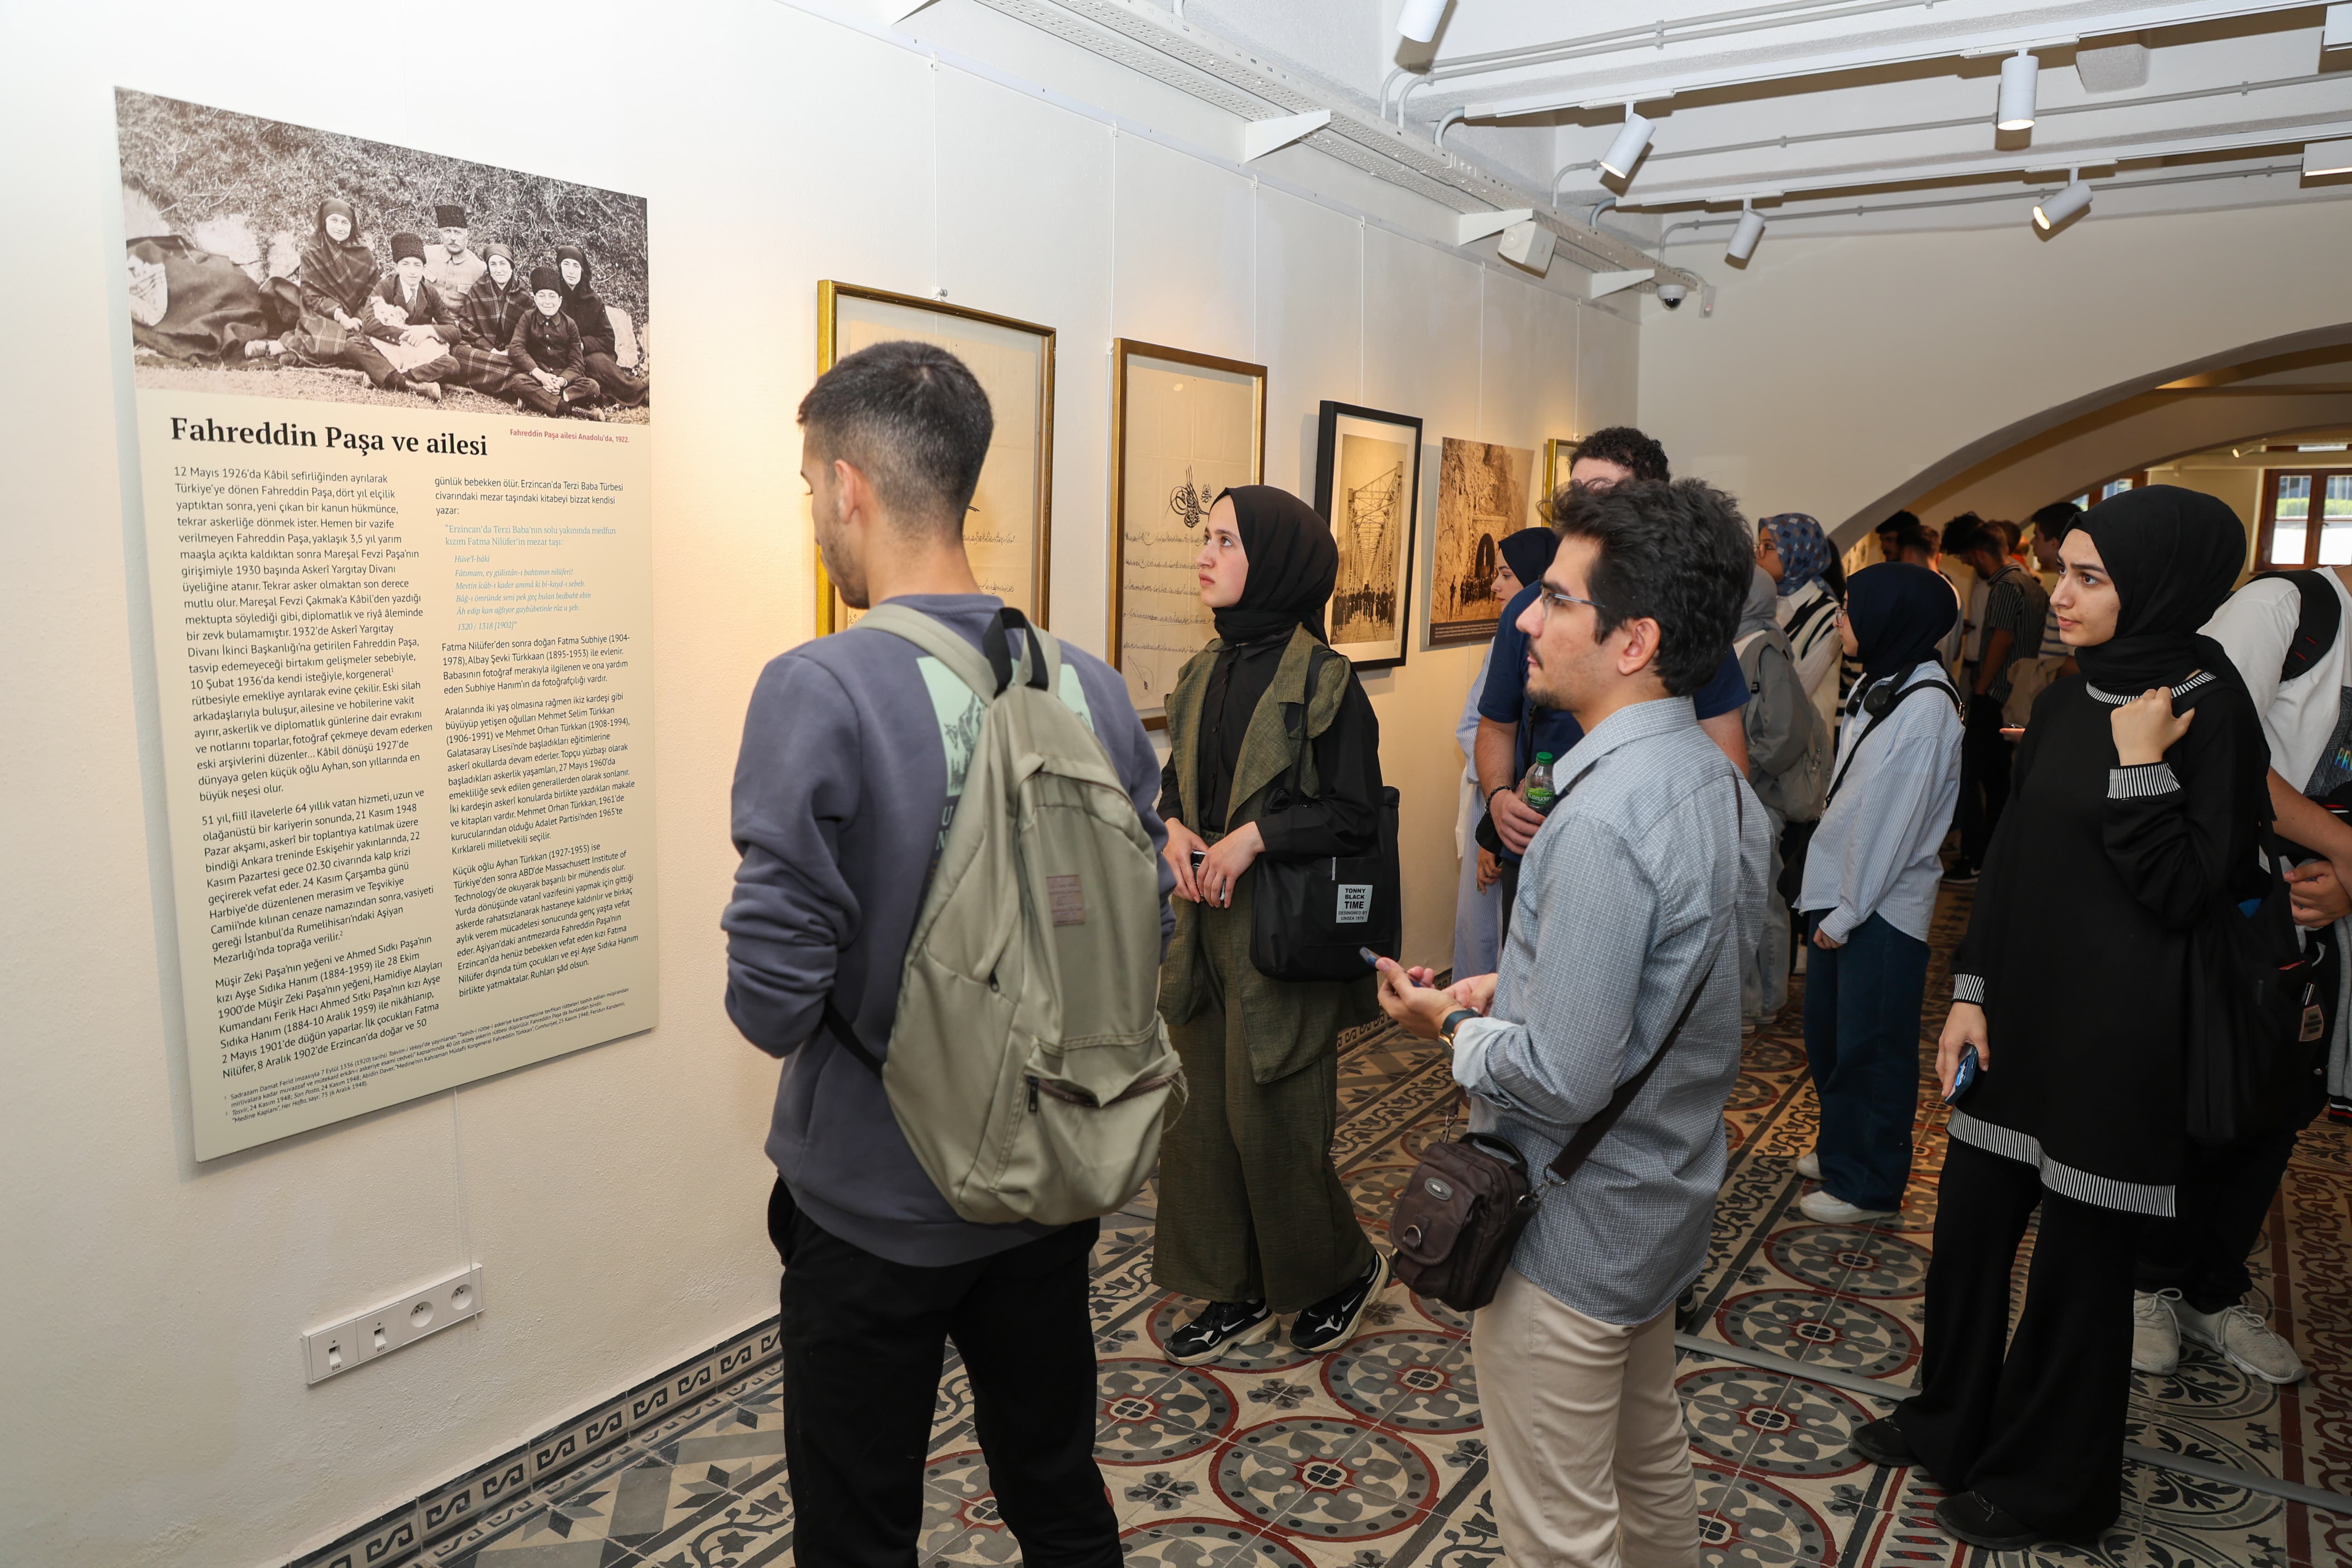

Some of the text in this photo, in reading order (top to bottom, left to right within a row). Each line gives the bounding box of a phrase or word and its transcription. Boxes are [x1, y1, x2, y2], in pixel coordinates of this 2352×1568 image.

[170, 417, 488, 457] Fahreddin Paşa ve ailesi
[509, 428, 543, 438] Fahreddin
[544, 430, 559, 441] Paşa
[560, 431, 577, 440] ailesi
[174, 466, 388, 485] 12 Mayıs 1926'da Kâbil sefirliğinden ayrılarak
[435, 491, 478, 501] civarındaki
[505, 493, 538, 504] taşındaki
[540, 493, 568, 505] kitabeyi
[569, 494, 591, 504] bizzat
[591, 495, 615, 504] kendisi
[435, 507, 459, 516] yazar:
[176, 516, 394, 529] tekrar askerliğe dönmek ister. Hemen bir vazife
[492, 525, 511, 533] Terzi
[543, 526, 558, 534] solu
[558, 526, 591, 536] yakınında
[591, 526, 616, 534] medfun
[445, 536, 466, 545] kızım
[467, 537, 491, 545] Fatma
[548, 538, 563, 547] taşı:
[181, 564, 396, 578] girişimiyle 1930 başında Askerî Yargıtay Divanı
[182, 581, 228, 594] üyeliğine
[231, 582, 261, 591] atanır.
[261, 580, 291, 590] Tekrar
[293, 580, 317, 590] asker
[319, 579, 362, 589] olmaktan
[381, 578, 409, 589] derece
[443, 670, 481, 680] Babasının
[482, 667, 513, 679] fotoğraf
[514, 665, 549, 675] merakıyla
[550, 663, 581, 674] ilgilenen
[605, 659, 628, 670] yardım
[192, 680, 421, 706] rütbesiyle emekliye ayrılarak evine çekilir. Eski silah
[446, 730, 493, 746] (1906-1991)
[505, 727, 536, 738] Mehmet
[537, 725, 559, 735] Orhan
[559, 722, 587, 732] Türkkan
[588, 717, 630, 731] (1908-1994),
[447, 742, 628, 772] askerî okullarda devam ederler. Topçu yüzbaşı olarak
[199, 783, 283, 803] büyük neşesi olur.
[1528, 793, 1551, 802] Kuzeyden
[203, 803, 417, 842] olağanüstü bir kariyerin sonunda, 21 Kasım 1948
[452, 831, 551, 855] Kırklareli milletvekili seçilir.
[206, 846, 411, 889] Kasım Pazartesi gece 02.30 civarında kalp krizi
[452, 843, 600, 877] Küçük oğlu Ayhan Türkkan (1927-1955) ise
[216, 952, 419, 1004] kızı Ayşe Sıdıka Hanım (1884-1959) ile 28 Ekim
[458, 959, 589, 997] birlikte yatmaktalar. Ruhları şâd olsun.
[220, 991, 434, 1049] Sıdıka Hanım (1884-10 Aralık 1959) ile nikâhlanıp,
